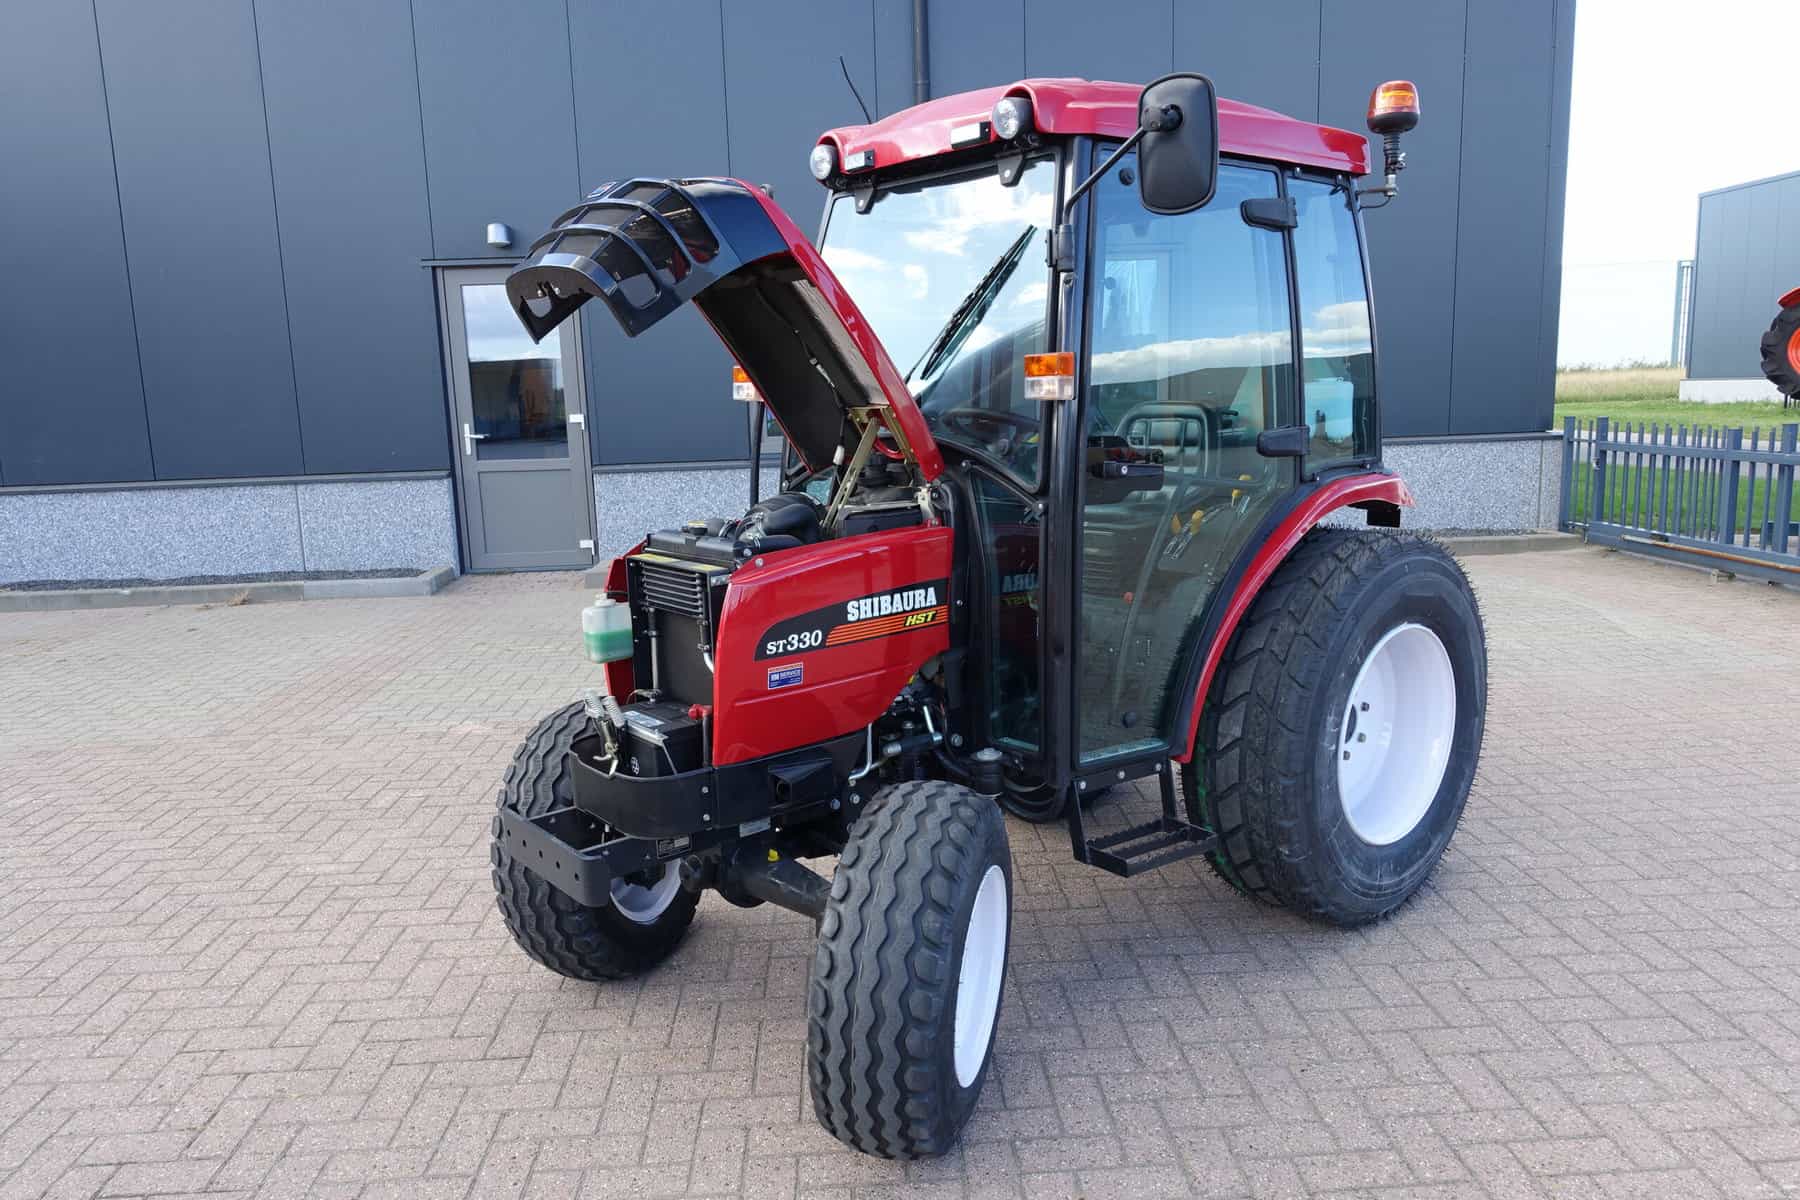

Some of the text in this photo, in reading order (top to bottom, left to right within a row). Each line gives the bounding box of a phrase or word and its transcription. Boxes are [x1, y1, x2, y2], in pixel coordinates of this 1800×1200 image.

[846, 587, 936, 621] SHIBAURA
[905, 611, 936, 626] HST
[766, 630, 822, 654] ST330
